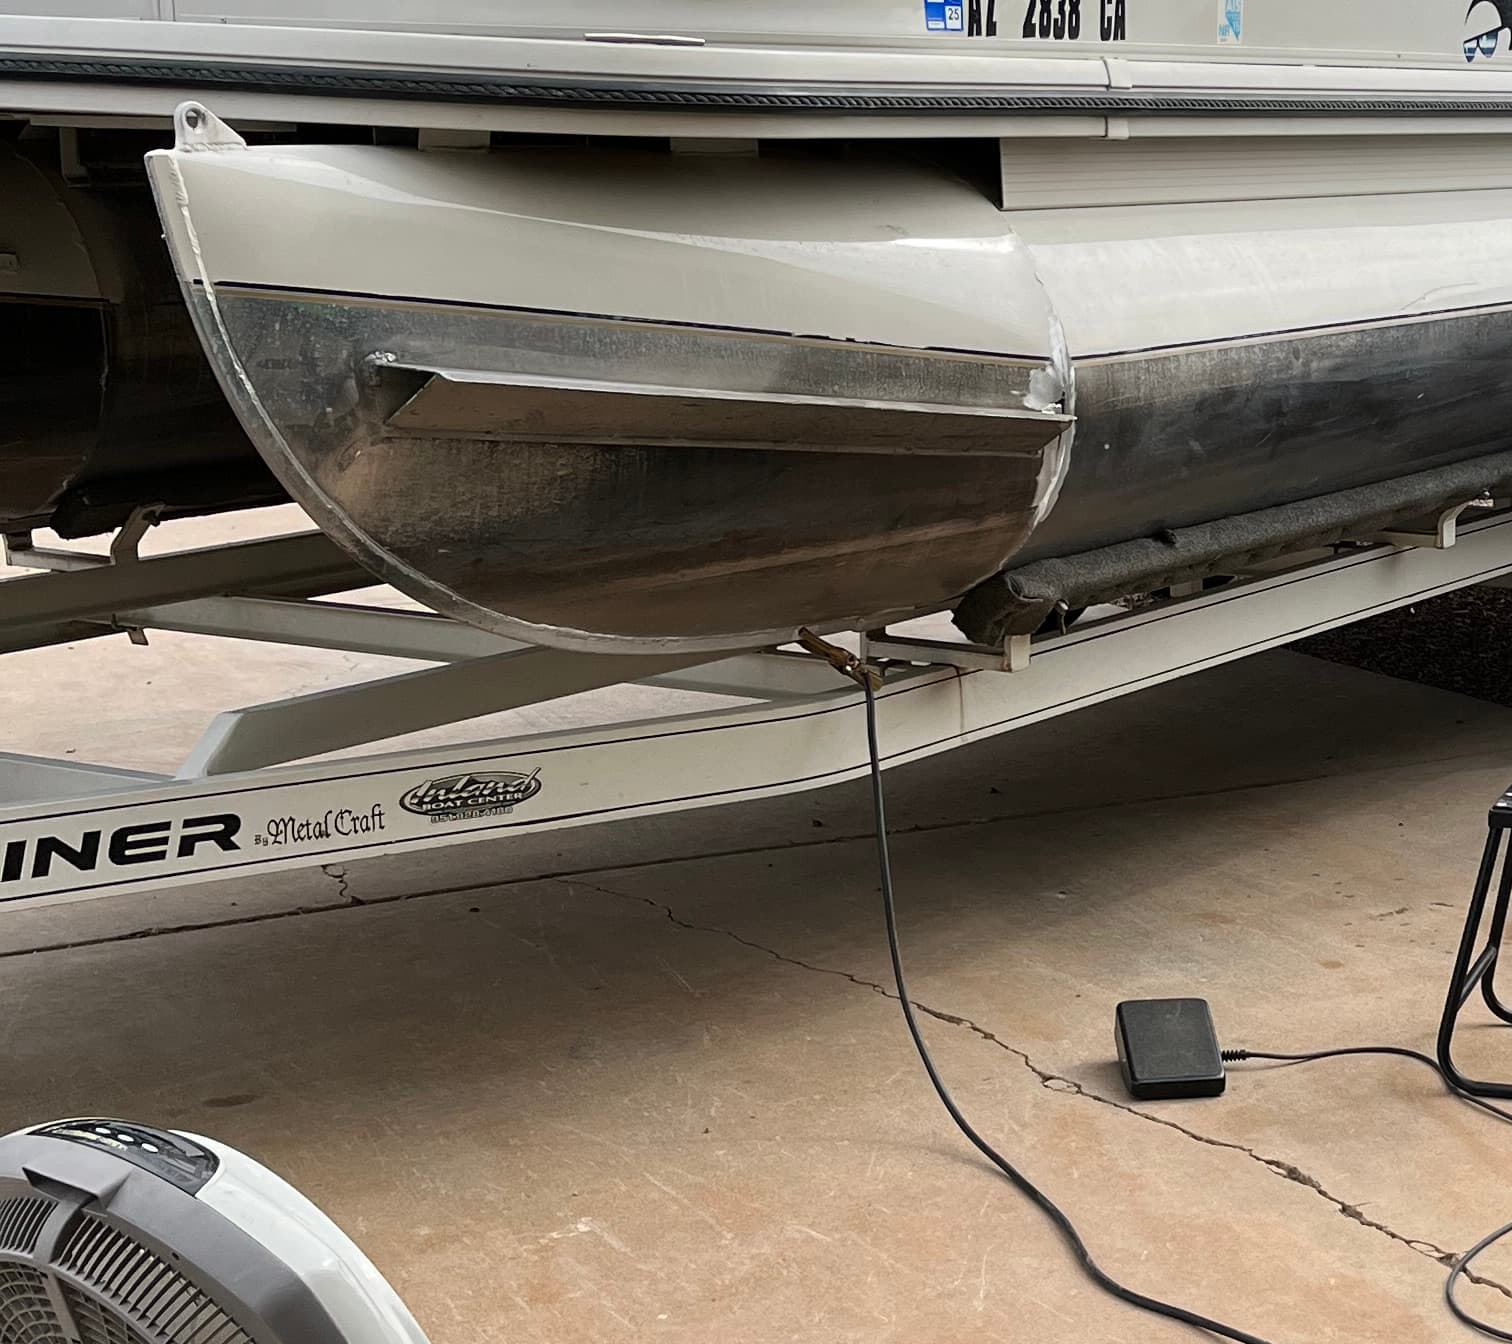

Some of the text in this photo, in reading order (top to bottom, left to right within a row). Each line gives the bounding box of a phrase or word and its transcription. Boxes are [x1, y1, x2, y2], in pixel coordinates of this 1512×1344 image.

[948, 7, 960, 21] 25
[410, 766, 542, 804] Inland
[423, 792, 523, 811] BOAT CENTER
[254, 803, 385, 847] By Metal Craft
